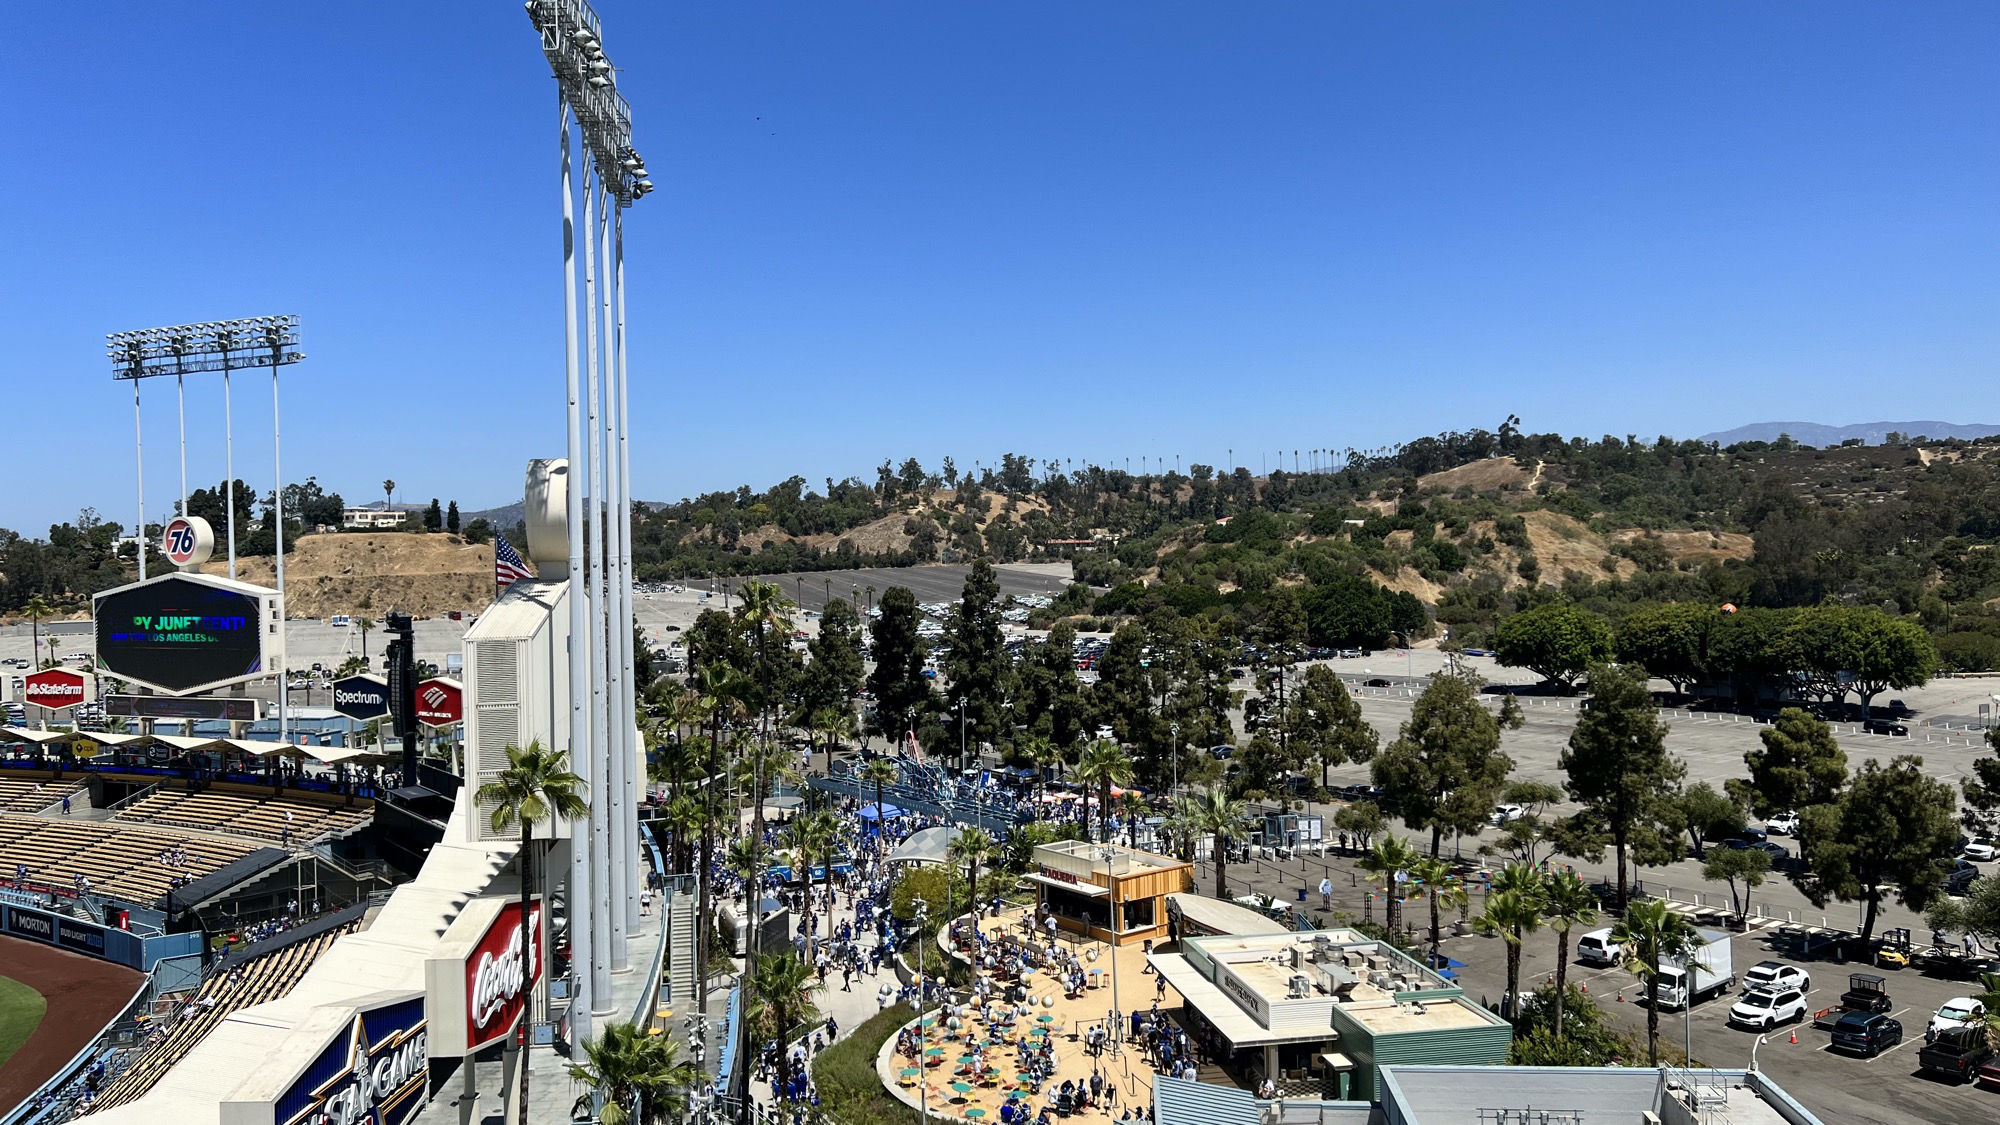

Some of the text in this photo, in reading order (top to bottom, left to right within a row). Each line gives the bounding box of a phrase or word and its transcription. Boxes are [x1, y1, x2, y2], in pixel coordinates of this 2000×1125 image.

[168, 526, 195, 555] 76
[148, 633, 165, 642] LOS
[166, 633, 207, 643] ANGELES
[335, 689, 380, 706] Spectrum
[1043, 867, 1078, 886] TAQUERIA
[18, 915, 51, 934] MORTON
[60, 927, 71, 938] BUD
[71, 929, 87, 942] LIGHT
[323, 1031, 428, 1125] STAR GAME
